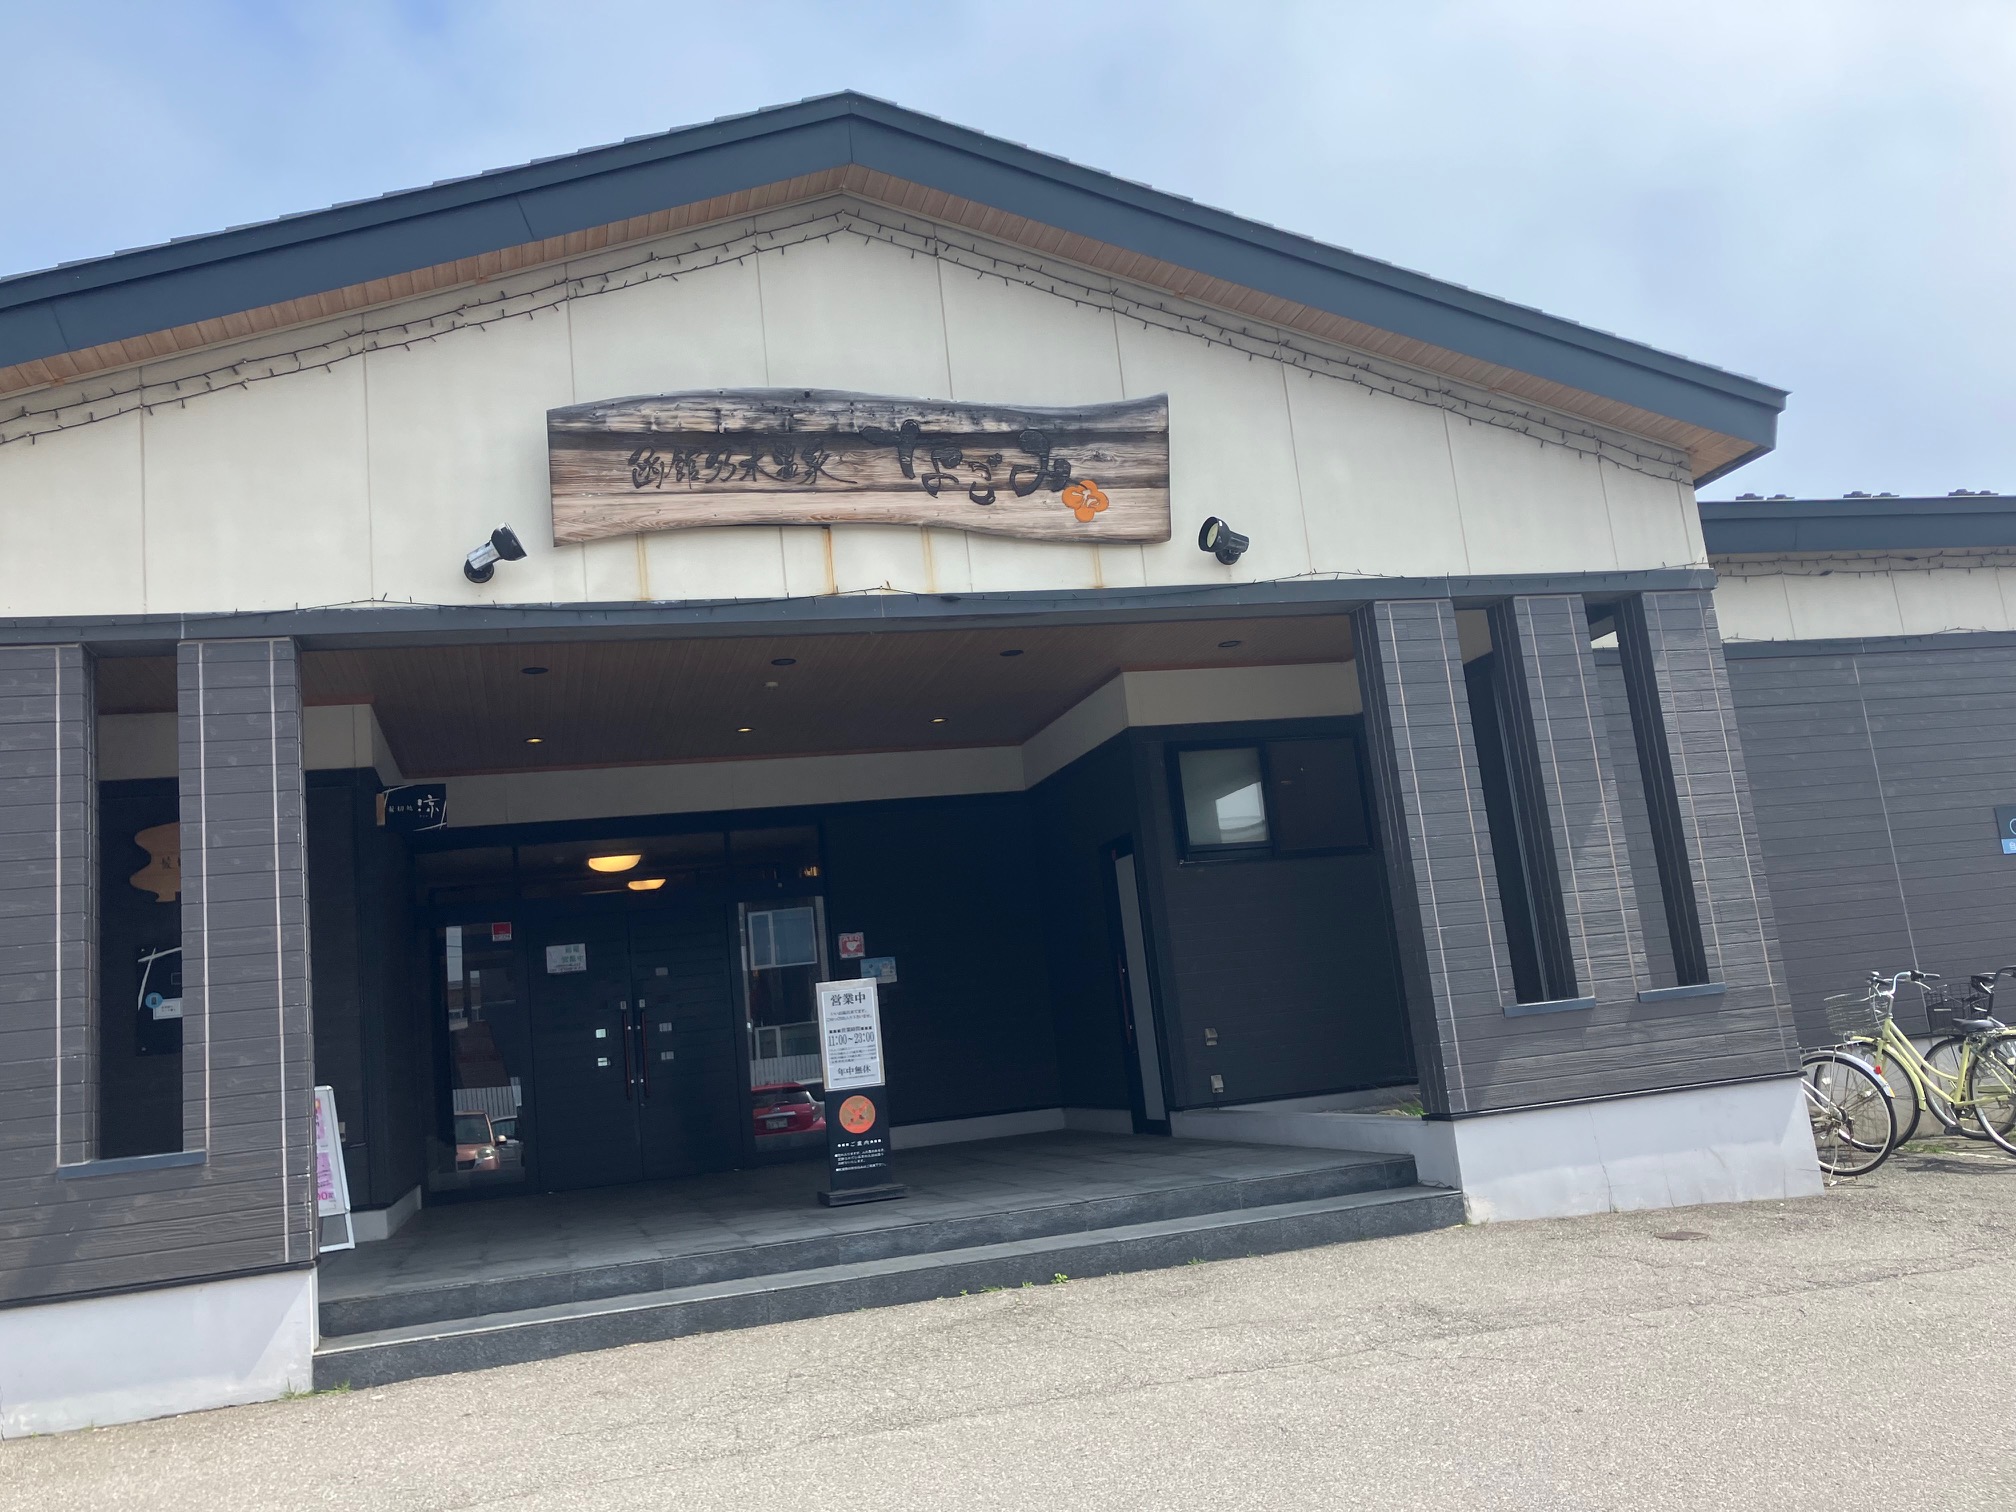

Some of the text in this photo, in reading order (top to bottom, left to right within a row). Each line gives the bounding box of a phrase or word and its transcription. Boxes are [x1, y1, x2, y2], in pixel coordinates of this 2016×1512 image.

[861, 419, 1072, 506] なごみ
[830, 991, 866, 1007] 営業中
[837, 1065, 872, 1076] 年中無休
